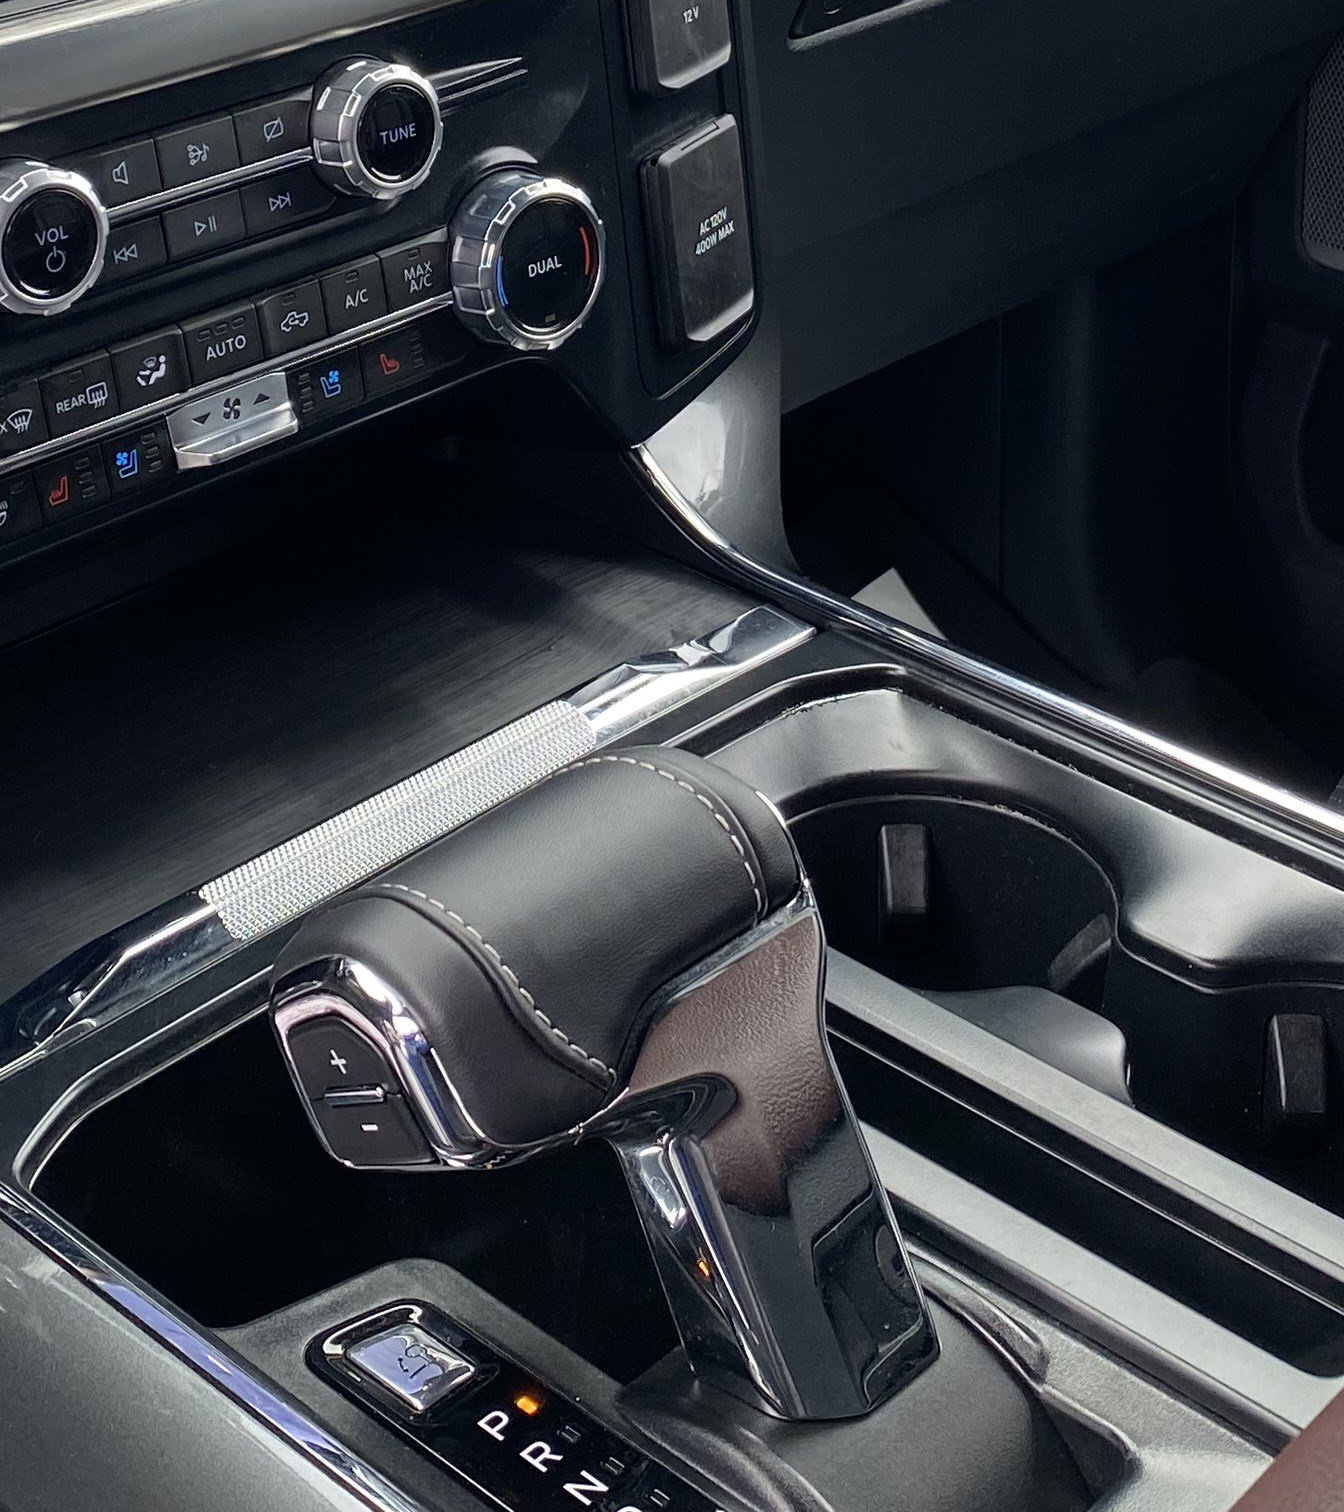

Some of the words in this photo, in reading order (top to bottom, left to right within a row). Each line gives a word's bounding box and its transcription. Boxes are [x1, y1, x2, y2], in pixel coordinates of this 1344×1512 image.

[379, 122, 417, 146] TUNE
[34, 224, 70, 248] VOL
[695, 231, 717, 255] 400W
[718, 220, 734, 241] MAX
[699, 218, 710, 236] AC
[404, 260, 433, 282] MAX
[527, 255, 563, 278] DUAL
[408, 274, 433, 294] A/C
[344, 288, 373, 311] A/C
[205, 335, 247, 361] AUTO
[56, 394, 87, 415] REAR
[477, 1410, 510, 1442] P
[519, 1441, 564, 1473] R
[562, 1469, 610, 1506] N
